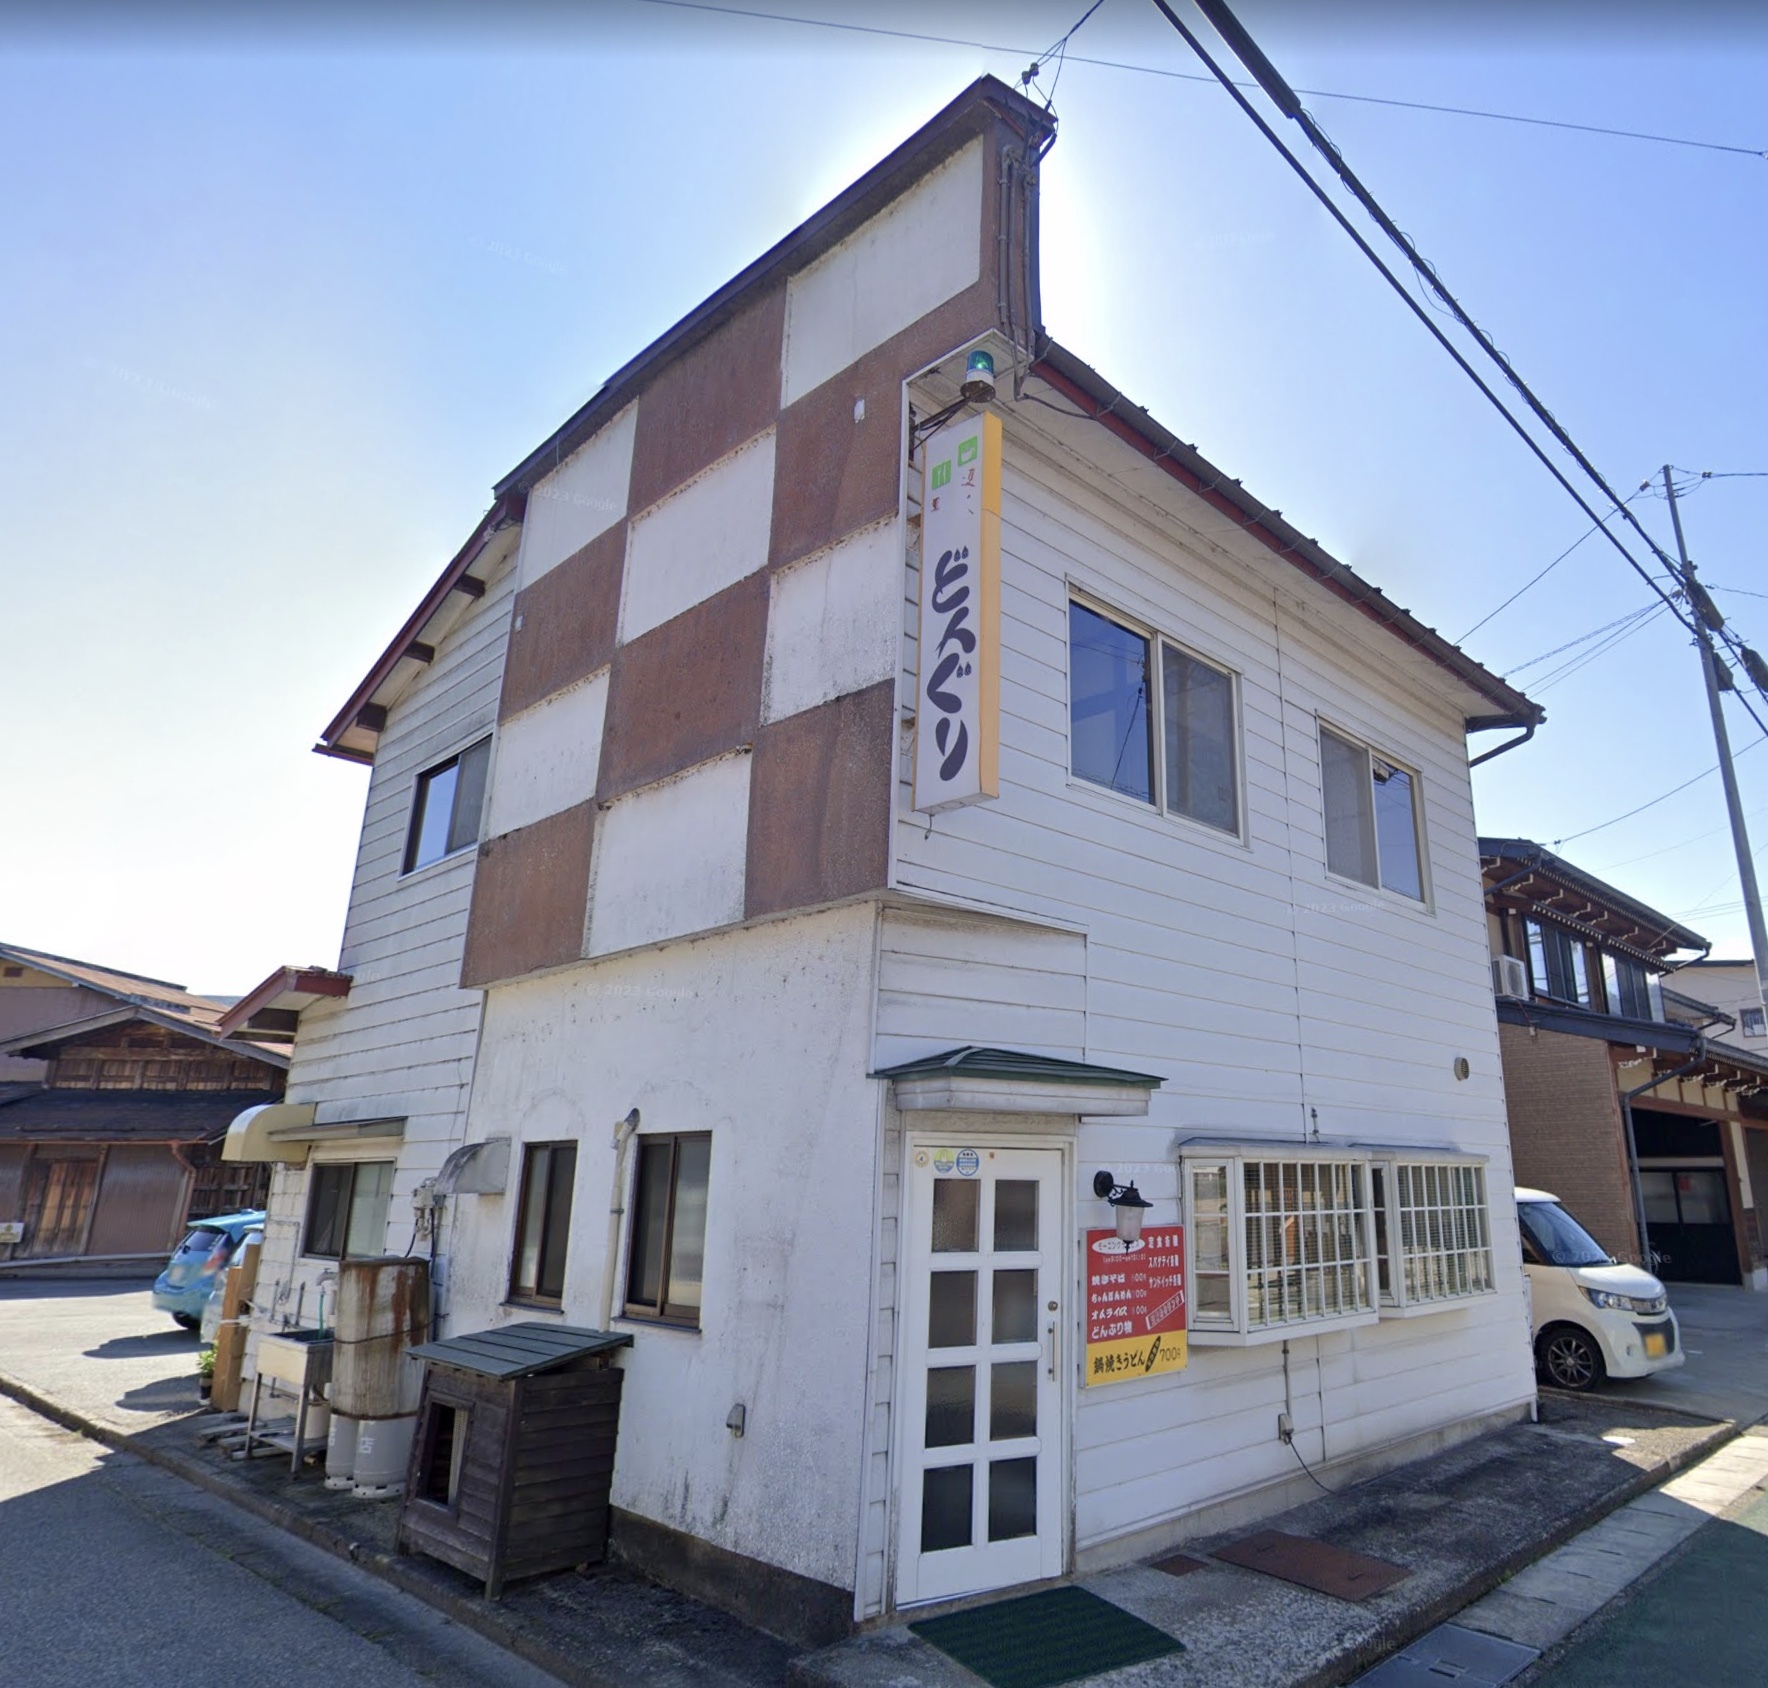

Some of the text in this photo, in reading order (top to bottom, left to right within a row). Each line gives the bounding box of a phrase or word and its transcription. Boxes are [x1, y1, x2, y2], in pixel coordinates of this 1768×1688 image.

[926, 545, 976, 782] どんぐり
[1091, 1305, 1128, 1321] オムライス
[1091, 1319, 1133, 1340] どんぶり物
[1093, 1349, 1146, 1375] 鍋焼きうどん
